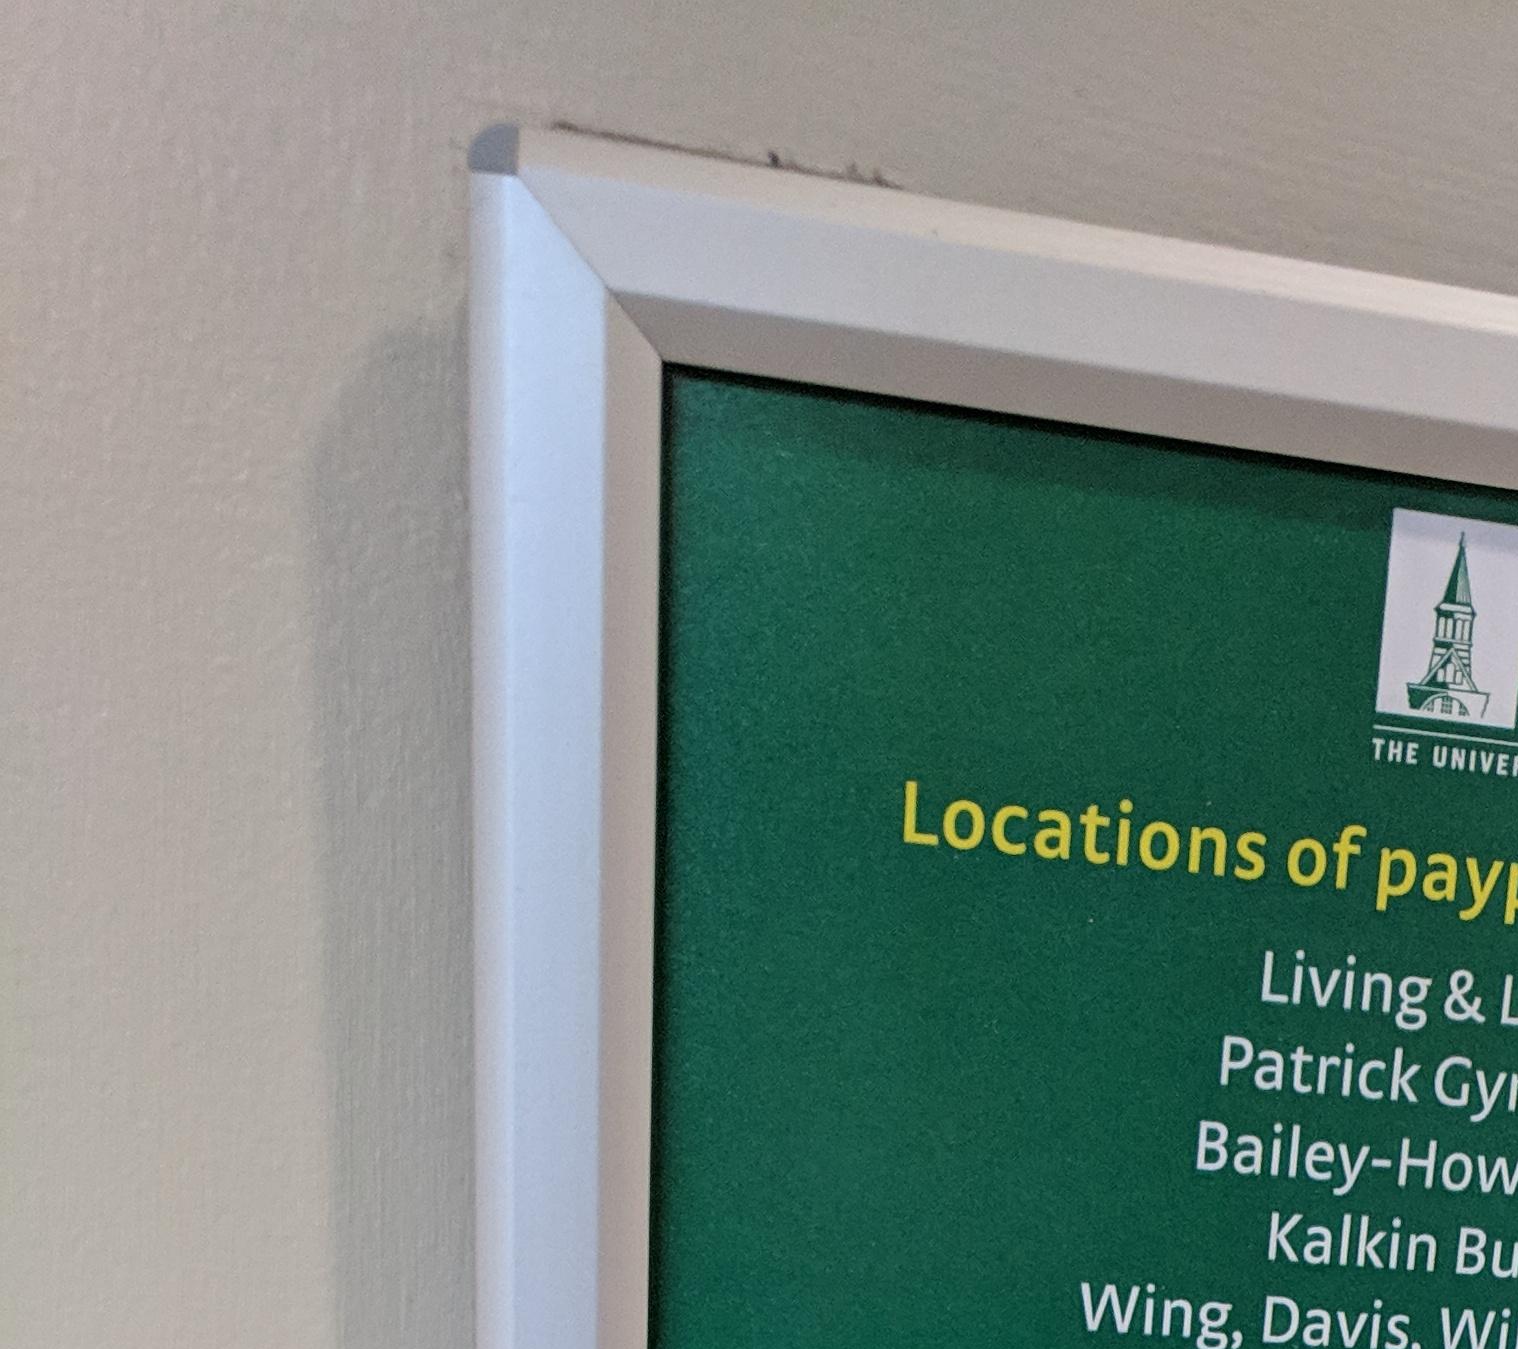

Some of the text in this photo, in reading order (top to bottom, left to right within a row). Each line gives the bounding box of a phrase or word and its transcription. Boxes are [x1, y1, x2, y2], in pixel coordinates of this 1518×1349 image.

[1372, 738, 1419, 764] THE
[903, 780, 1267, 880] Locations
[1287, 824, 1367, 889] of
[1261, 949, 1433, 1031] Living
[1444, 969, 1486, 1023] &
[1220, 1035, 1421, 1103] Patrick
[1268, 1212, 1437, 1272] Kalkin
